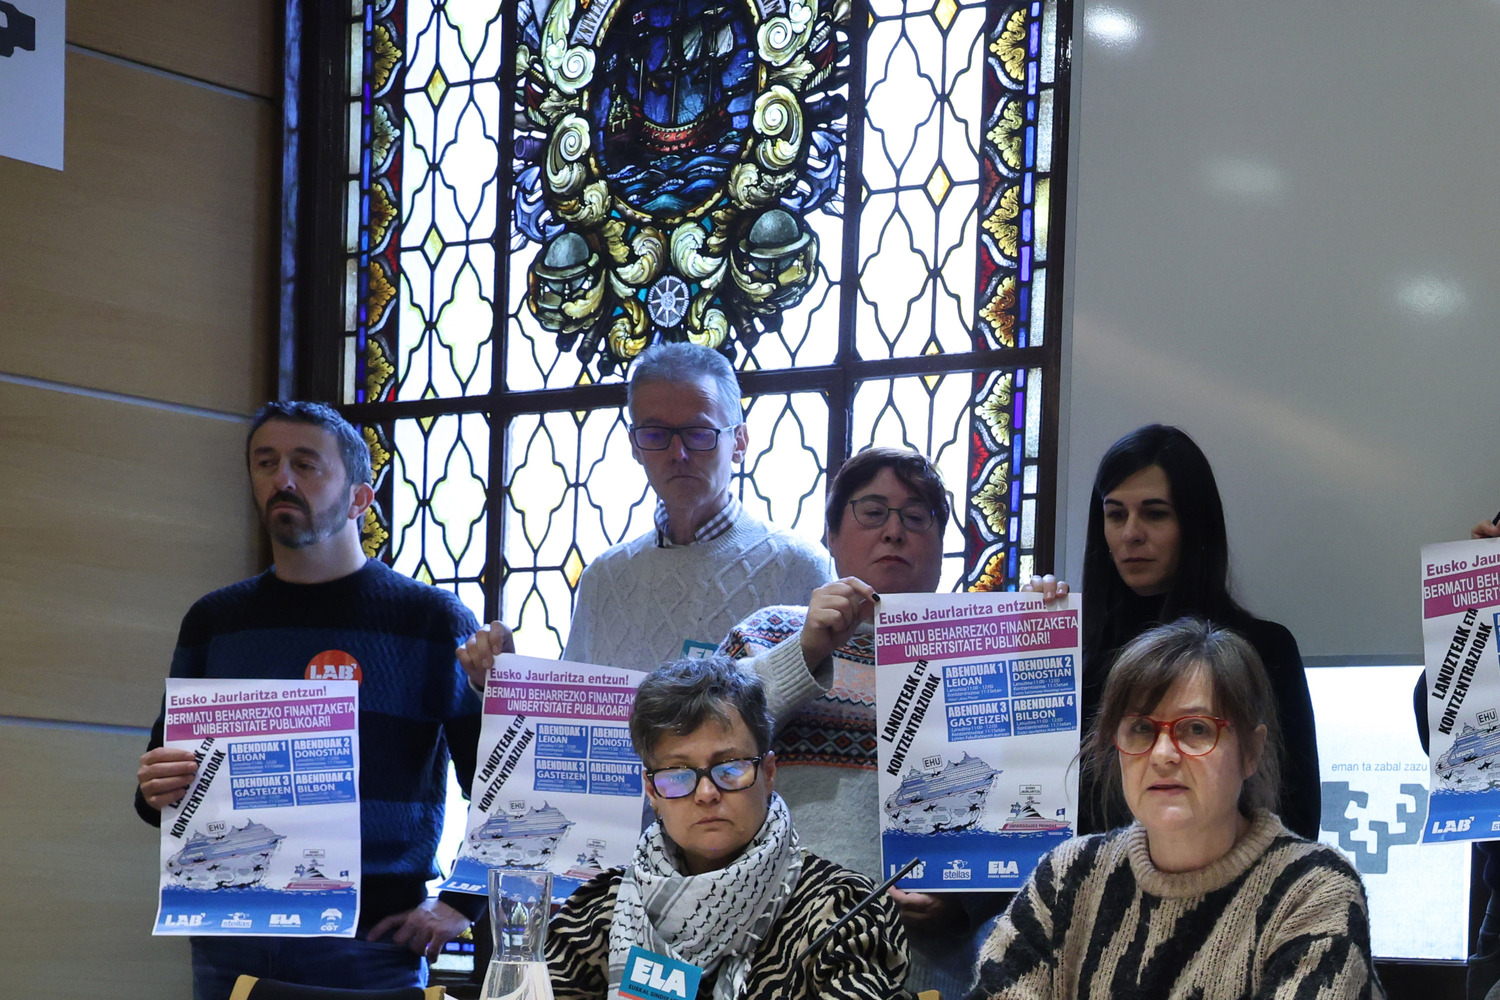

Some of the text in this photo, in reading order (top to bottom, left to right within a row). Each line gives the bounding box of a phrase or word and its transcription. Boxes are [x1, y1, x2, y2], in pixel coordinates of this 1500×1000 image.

[1426, 557, 1467, 576] Eusko
[876, 615, 1078, 646] BERMATU BEHARREZKO FINANTZAKETA
[310, 663, 357, 680] LAB
[489, 668, 629, 685] Eusko Jaurlaritza entzun!
[170, 686, 326, 706] Eusko Jaurlaritza entzun!
[1331, 762, 1427, 771] eman ta zabal zazu
[630, 956, 686, 998] ELA
